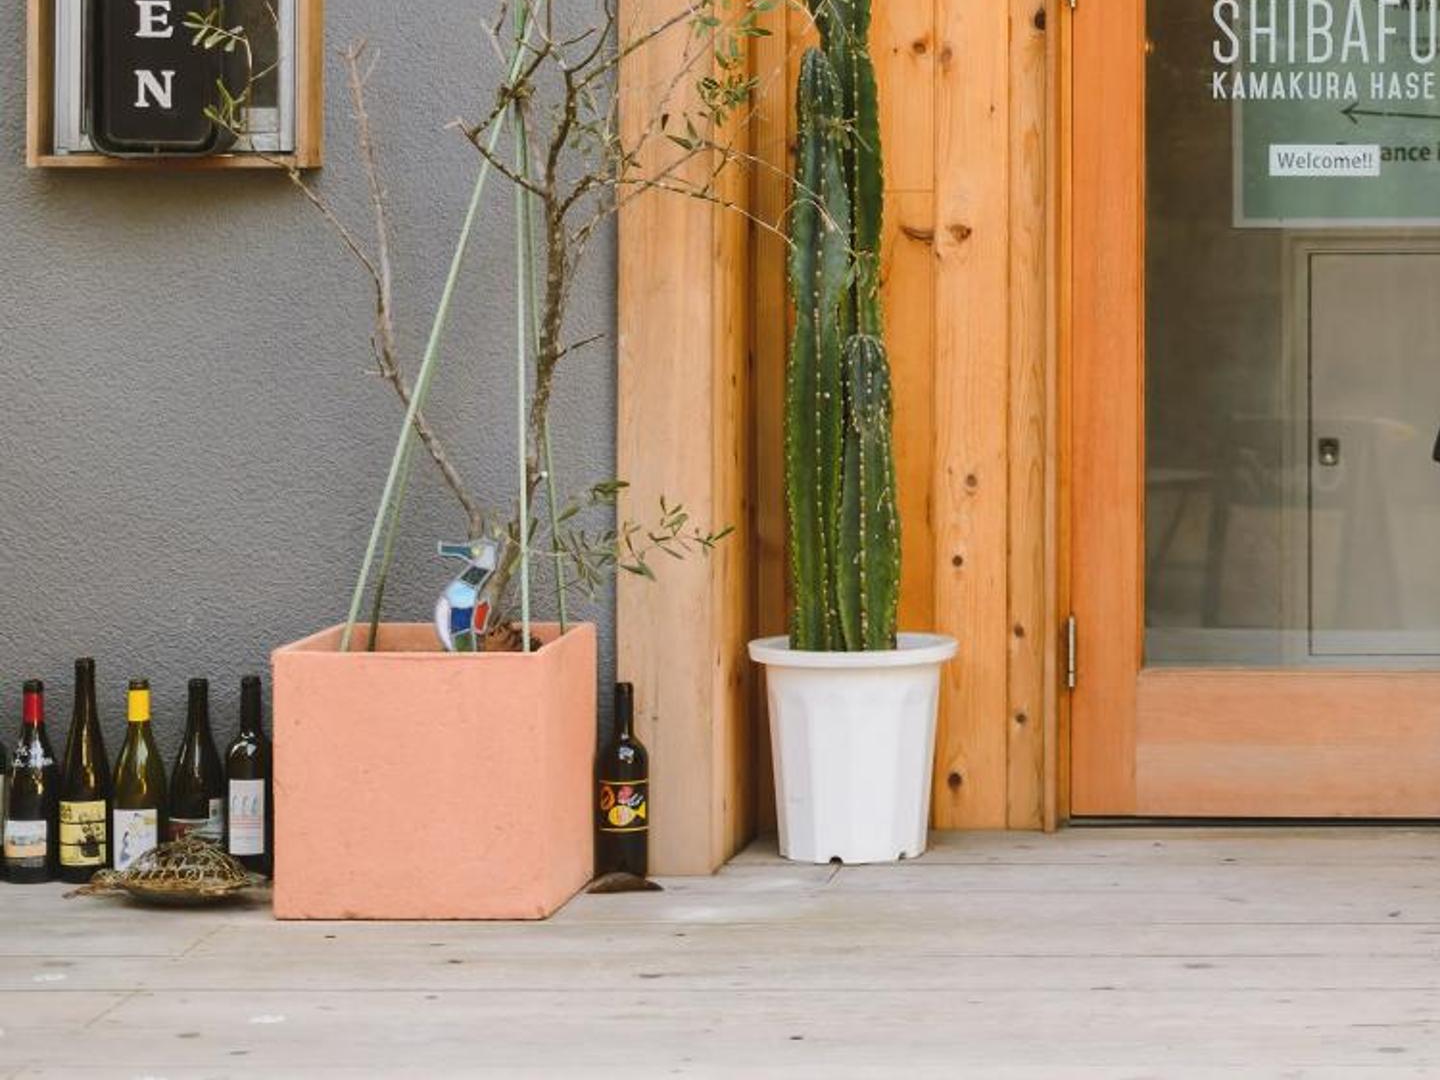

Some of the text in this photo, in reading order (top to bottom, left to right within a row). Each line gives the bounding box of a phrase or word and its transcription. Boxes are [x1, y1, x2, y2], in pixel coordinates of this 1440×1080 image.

[1212, 72, 1435, 100] KAMAKURA HASE
[1277, 151, 1373, 170] Welcome!!
